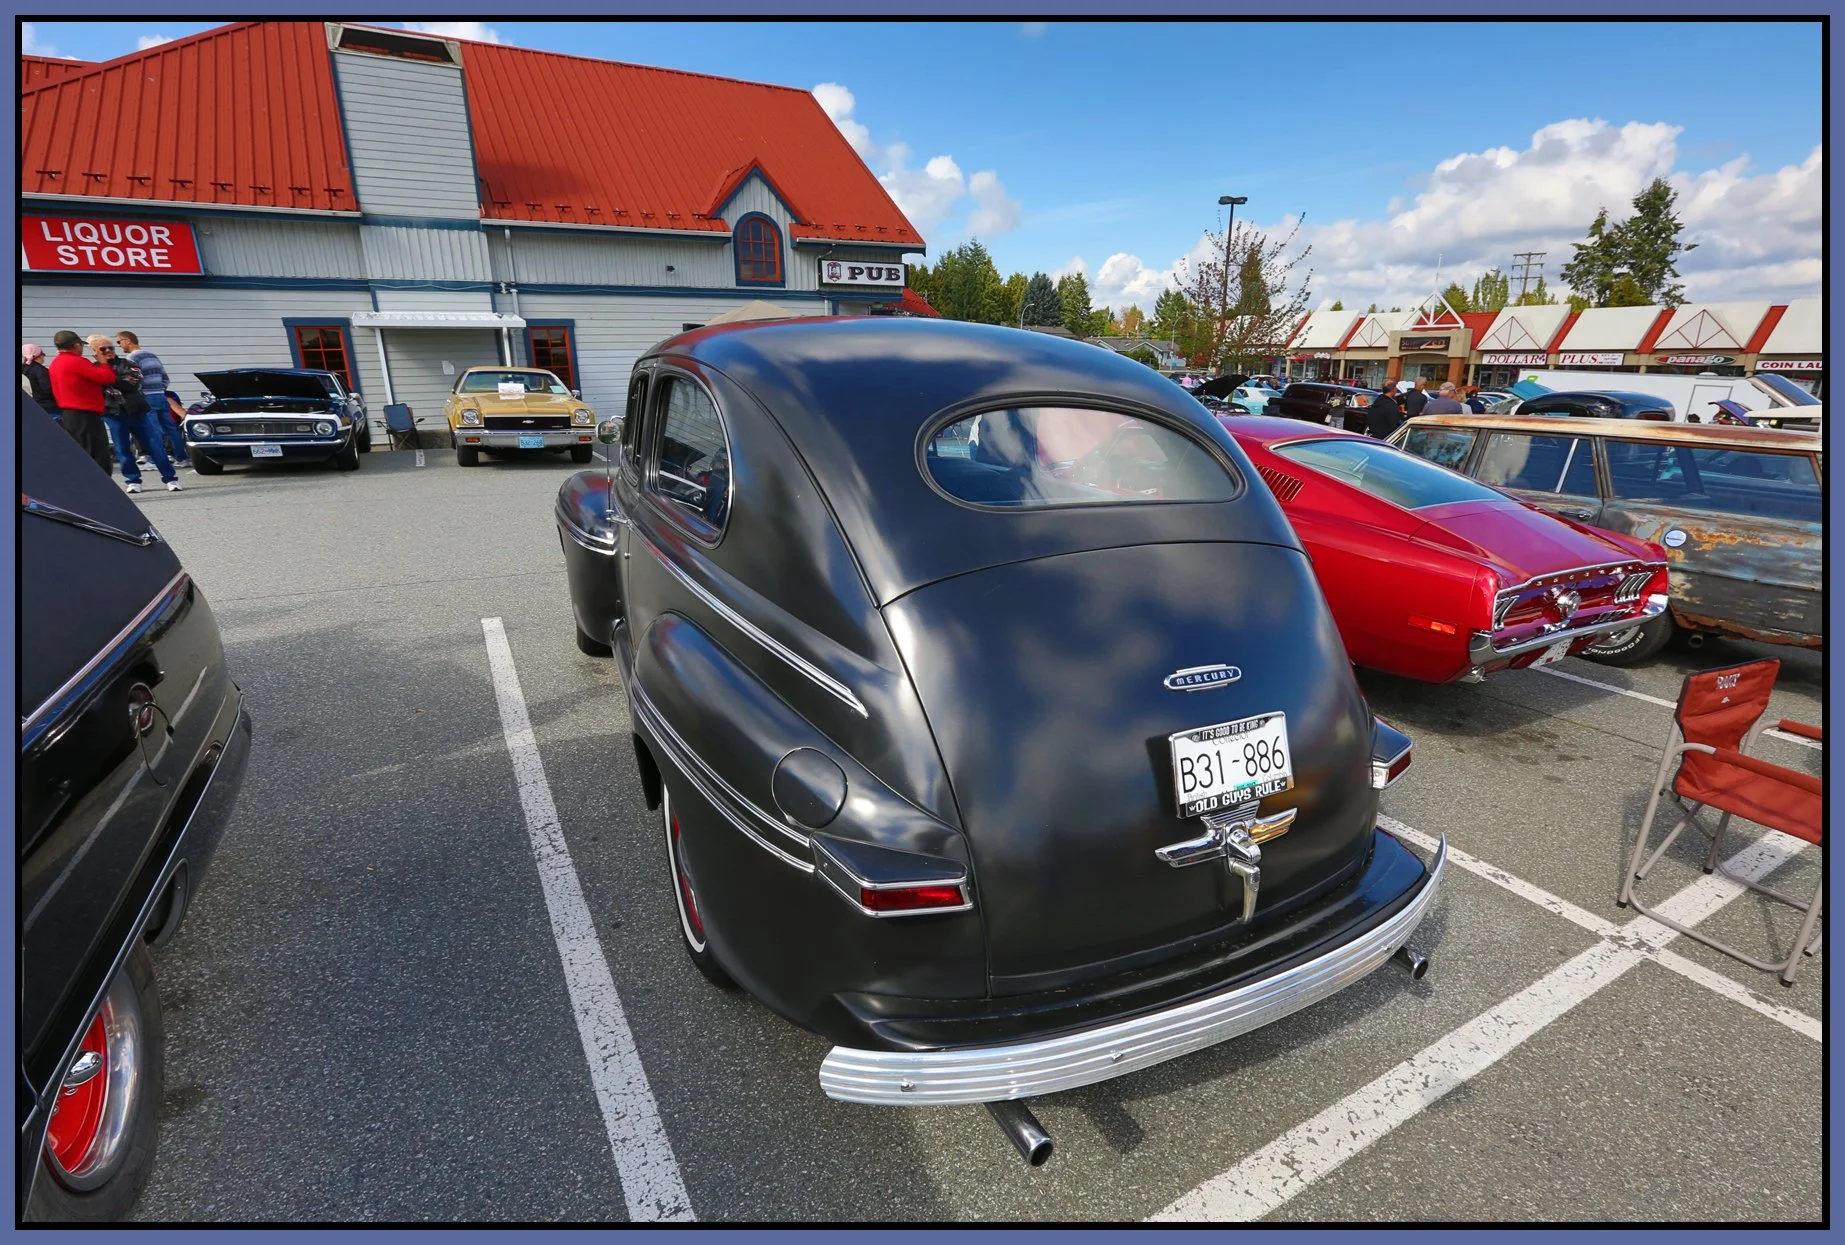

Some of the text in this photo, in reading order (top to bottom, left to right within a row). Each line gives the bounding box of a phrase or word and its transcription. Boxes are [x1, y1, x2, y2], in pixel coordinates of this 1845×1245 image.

[40, 221, 174, 246] LIQUOR
[57, 245, 172, 268] STORE
[848, 266, 901, 281] PUB
[1487, 354, 1539, 364] DOLLAR
[1560, 354, 1598, 364] PLUS
[1667, 354, 1725, 365] panago
[1175, 669, 1235, 686] MERCURY
[1202, 719, 1259, 740] IT'S GOOD TO BE KING
[1180, 736, 1285, 794] B31-886
[1195, 796, 1218, 813] OLD
[1222, 788, 1252, 805] GUYS
[1255, 780, 1282, 797] RULE
